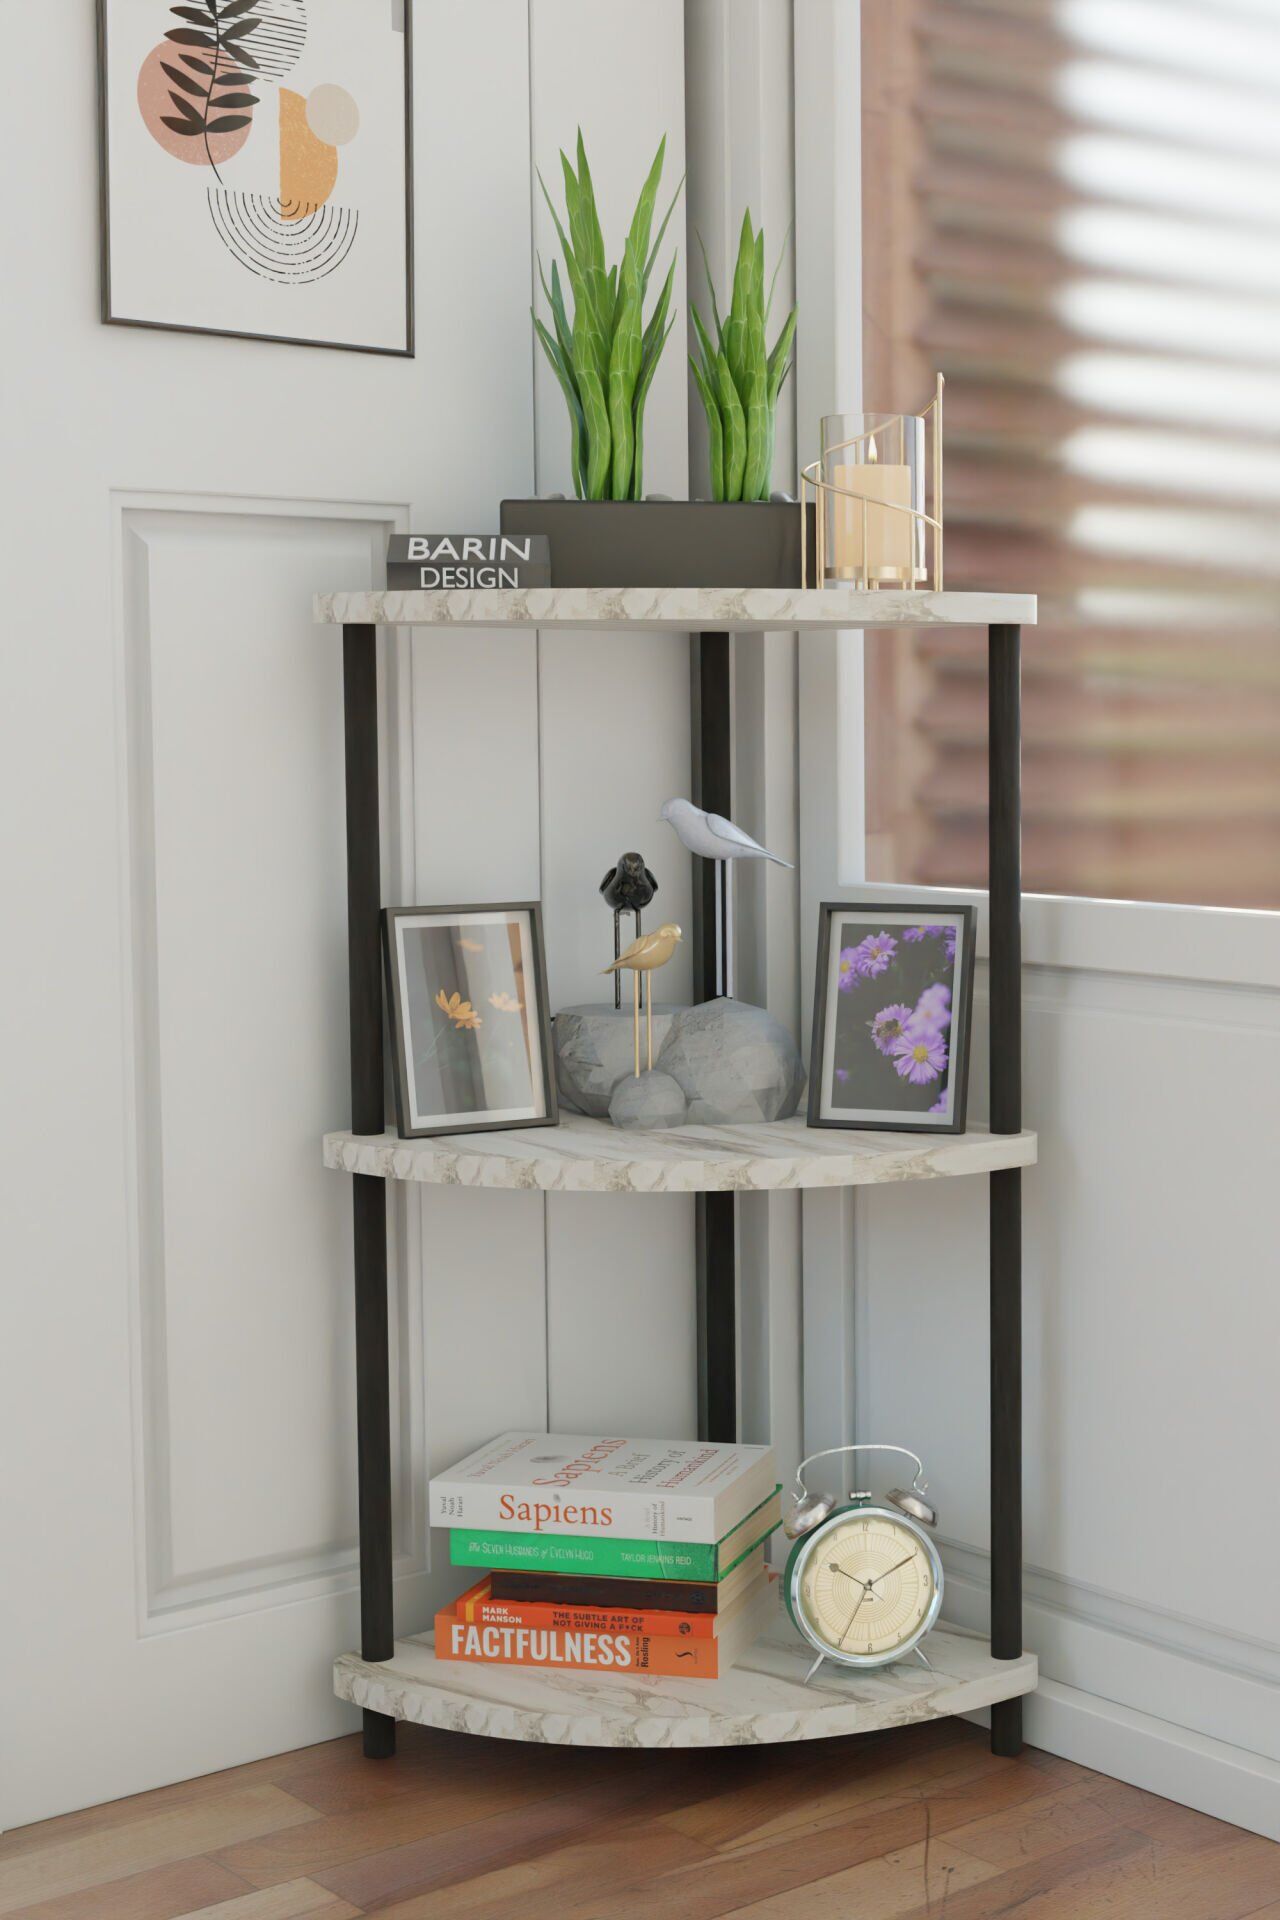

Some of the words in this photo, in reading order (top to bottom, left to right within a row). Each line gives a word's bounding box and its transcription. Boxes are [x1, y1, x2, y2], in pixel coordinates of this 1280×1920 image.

[407, 537, 531, 560] BARIN
[420, 567, 518, 588] DESIGN
[532, 1439, 628, 1487] Sapiens
[628, 1458, 682, 1484] History
[656, 1449, 720, 1489] Humankind
[499, 1494, 613, 1531] Sapiens
[482, 1542, 504, 1555] SEVEN
[621, 1552, 646, 1563] TAYLOR
[647, 1554, 675, 1564] JENKINS
[676, 1556, 692, 1566] REID
[923, 1574, 929, 1587] 3
[482, 1606, 508, 1615] MARK
[482, 1614, 522, 1624] MANSON
[553, 1611, 570, 1620] THE
[573, 1612, 608, 1622] SUBTLE
[611, 1615, 630, 1623] ART
[553, 1619, 571, 1628] NOT
[574, 1620, 606, 1630] GIVING
[451, 1624, 631, 1667] FACTFULNESS
[640, 1636, 650, 1668] Rosling
